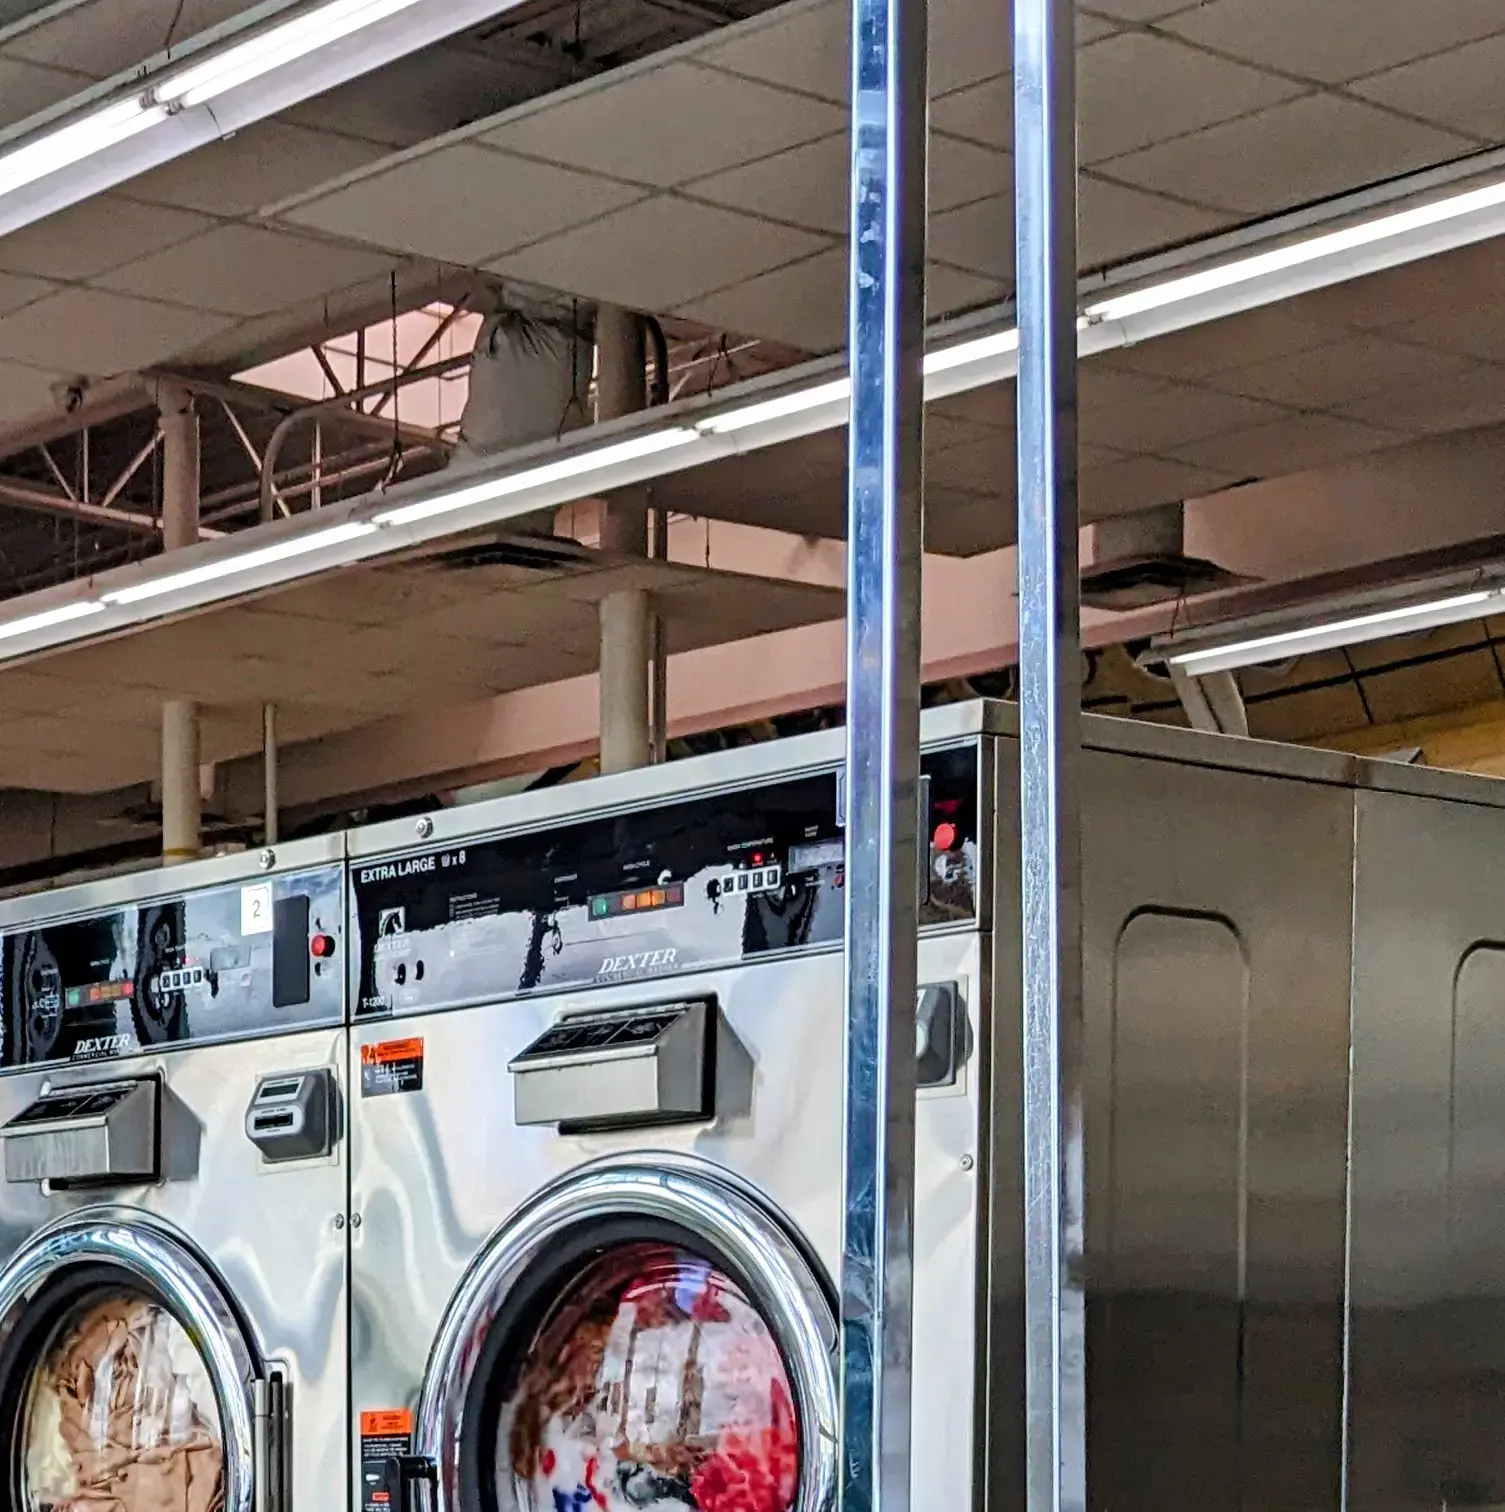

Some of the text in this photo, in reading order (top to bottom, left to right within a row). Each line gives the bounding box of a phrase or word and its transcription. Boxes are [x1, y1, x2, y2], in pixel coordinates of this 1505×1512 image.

[360, 869, 396, 883] EXTRA
[398, 857, 435, 875] LARGE
[458, 850, 467, 864] 8
[252, 899, 261, 918] 2
[598, 948, 676, 974] DEXTER
[74, 1033, 130, 1054] DEXTER
